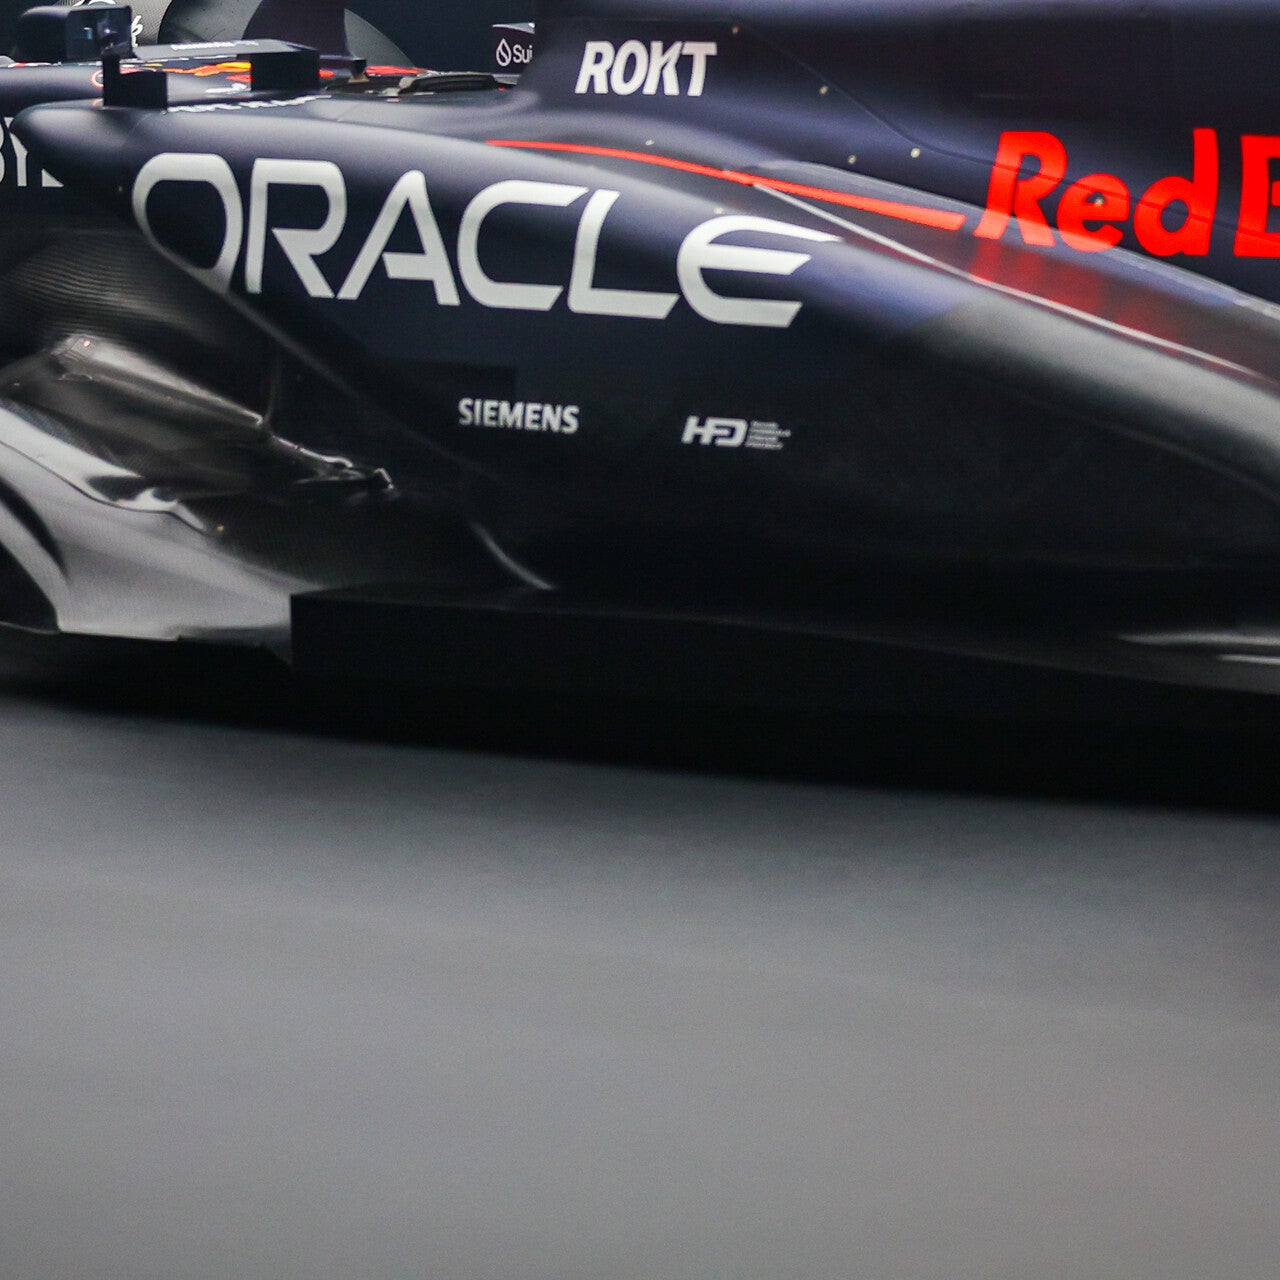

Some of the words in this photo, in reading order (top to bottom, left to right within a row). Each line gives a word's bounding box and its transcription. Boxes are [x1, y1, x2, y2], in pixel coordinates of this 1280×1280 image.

[512, 44, 534, 65] Sui
[575, 39, 718, 97] ROKT
[973, 128, 1218, 254] Red
[131, 152, 843, 327] ORACLE
[458, 397, 580, 434] SIEMENS
